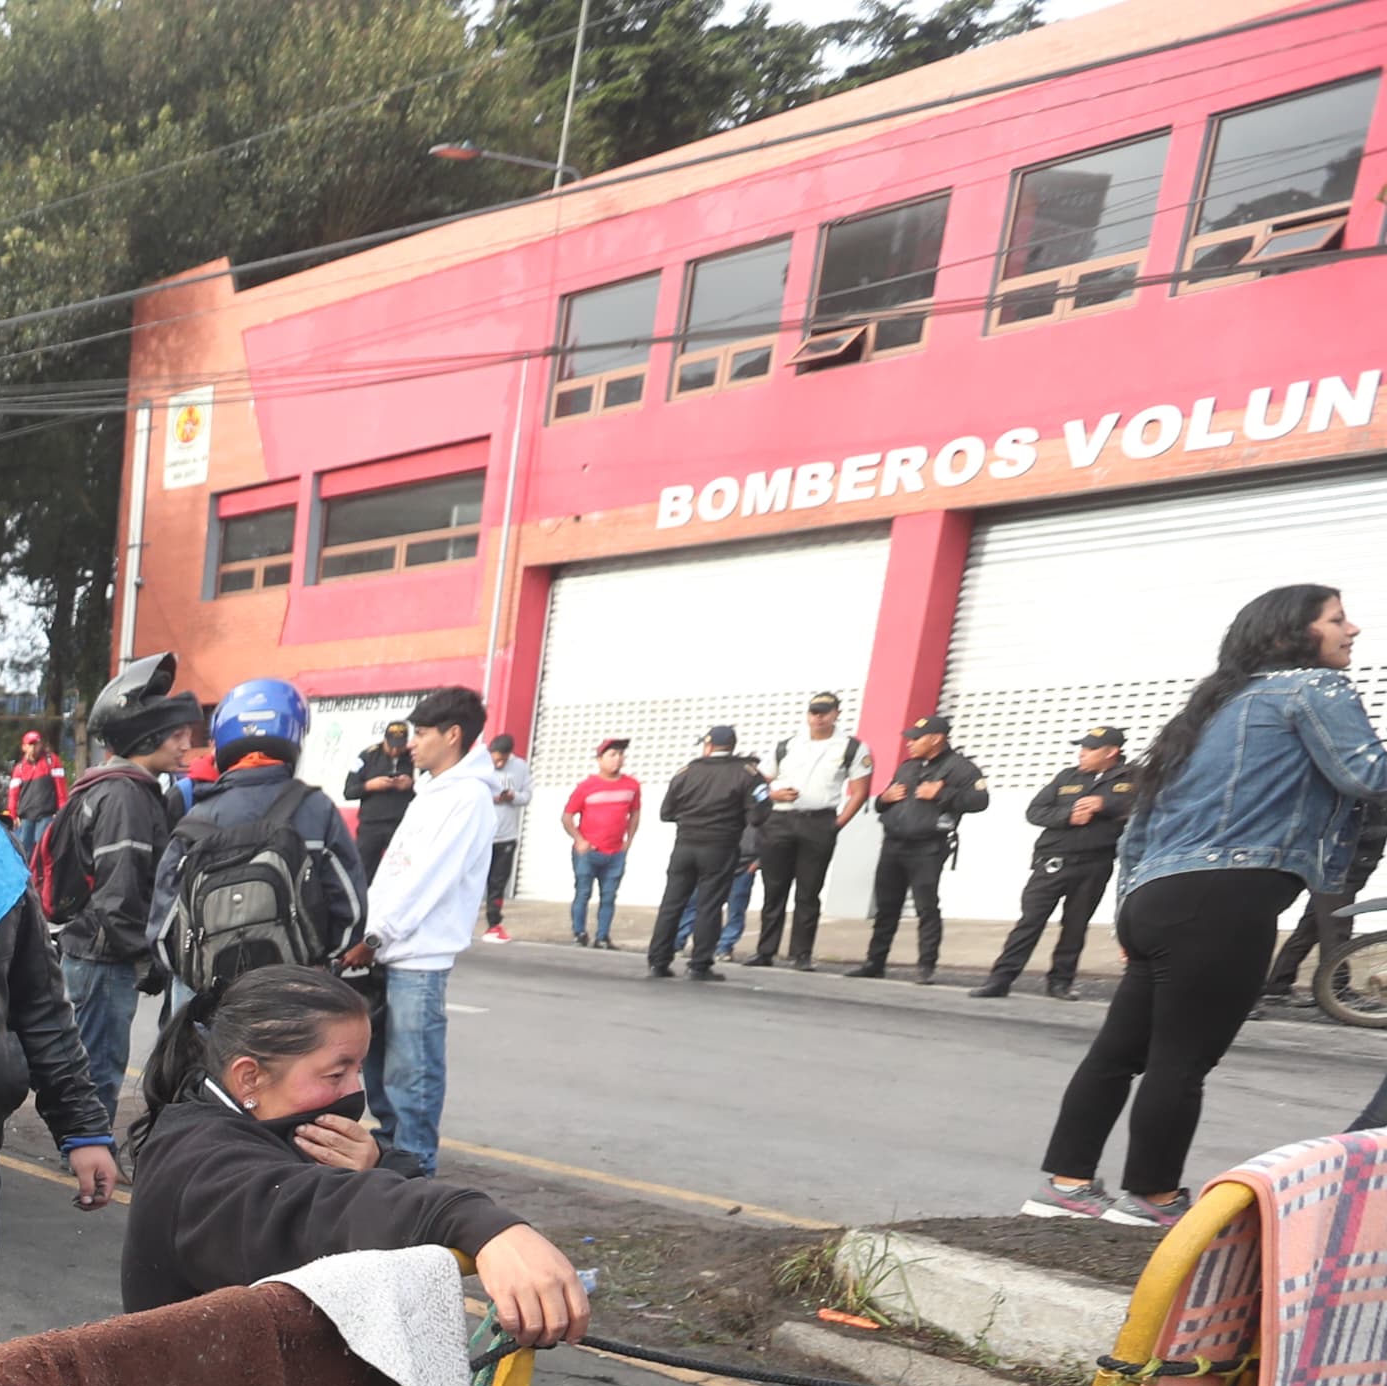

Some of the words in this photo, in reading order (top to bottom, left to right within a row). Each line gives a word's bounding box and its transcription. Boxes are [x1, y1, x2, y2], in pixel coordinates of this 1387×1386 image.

[655, 427, 1039, 530] BOMBEROS
[1063, 369, 1383, 469] VOLUN
[317, 695, 380, 713] BOMBEROS
